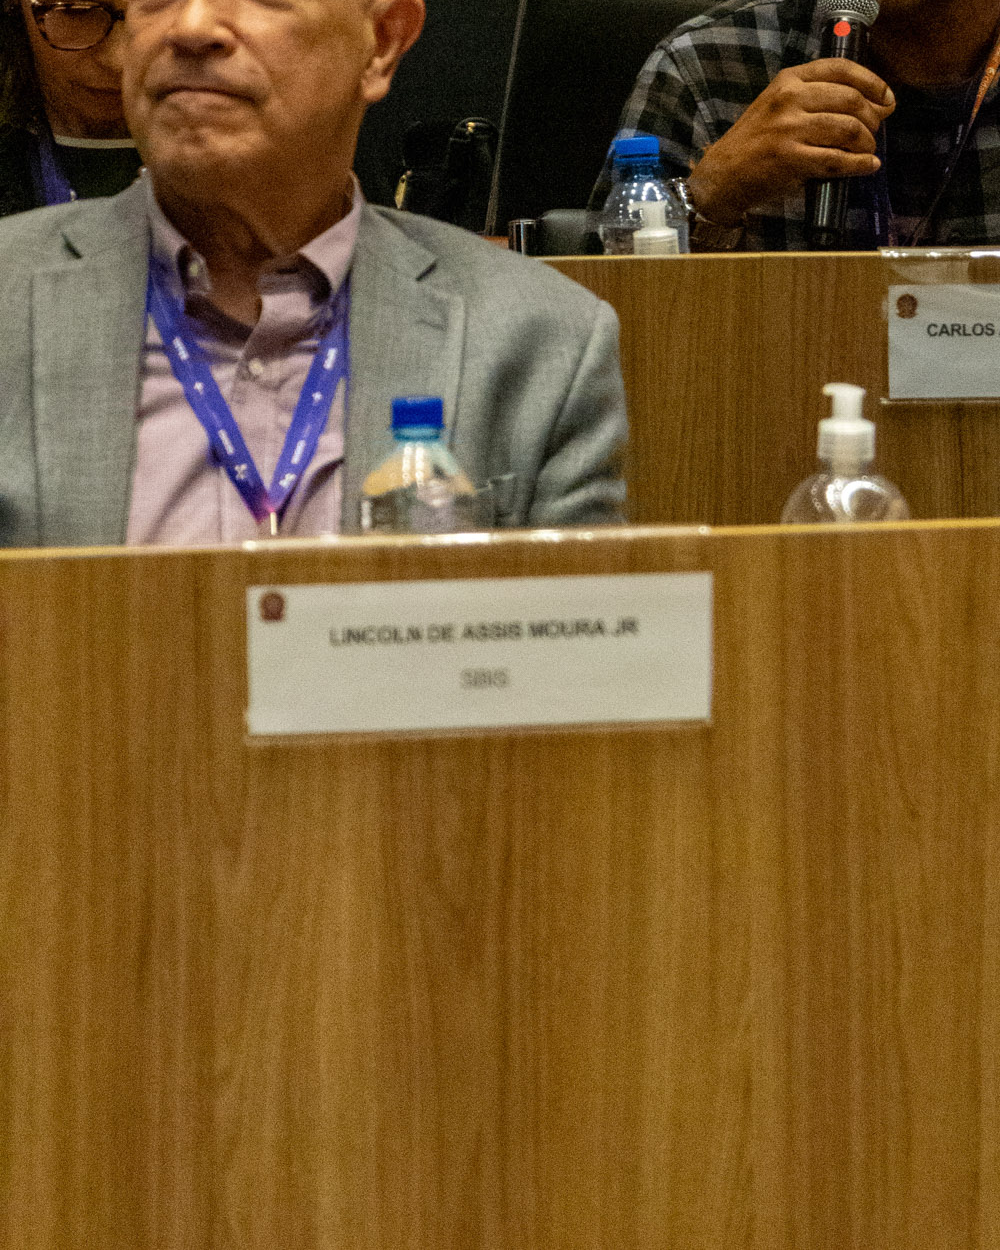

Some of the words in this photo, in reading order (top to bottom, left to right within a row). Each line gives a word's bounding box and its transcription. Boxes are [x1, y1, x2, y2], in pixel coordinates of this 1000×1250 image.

[926, 322, 996, 337] CARLOS
[329, 625, 422, 647] LINCOLN
[426, 622, 454, 644] DE
[461, 621, 522, 642] ASSIS
[527, 618, 605, 640] MOURA
[611, 616, 639, 638] JR
